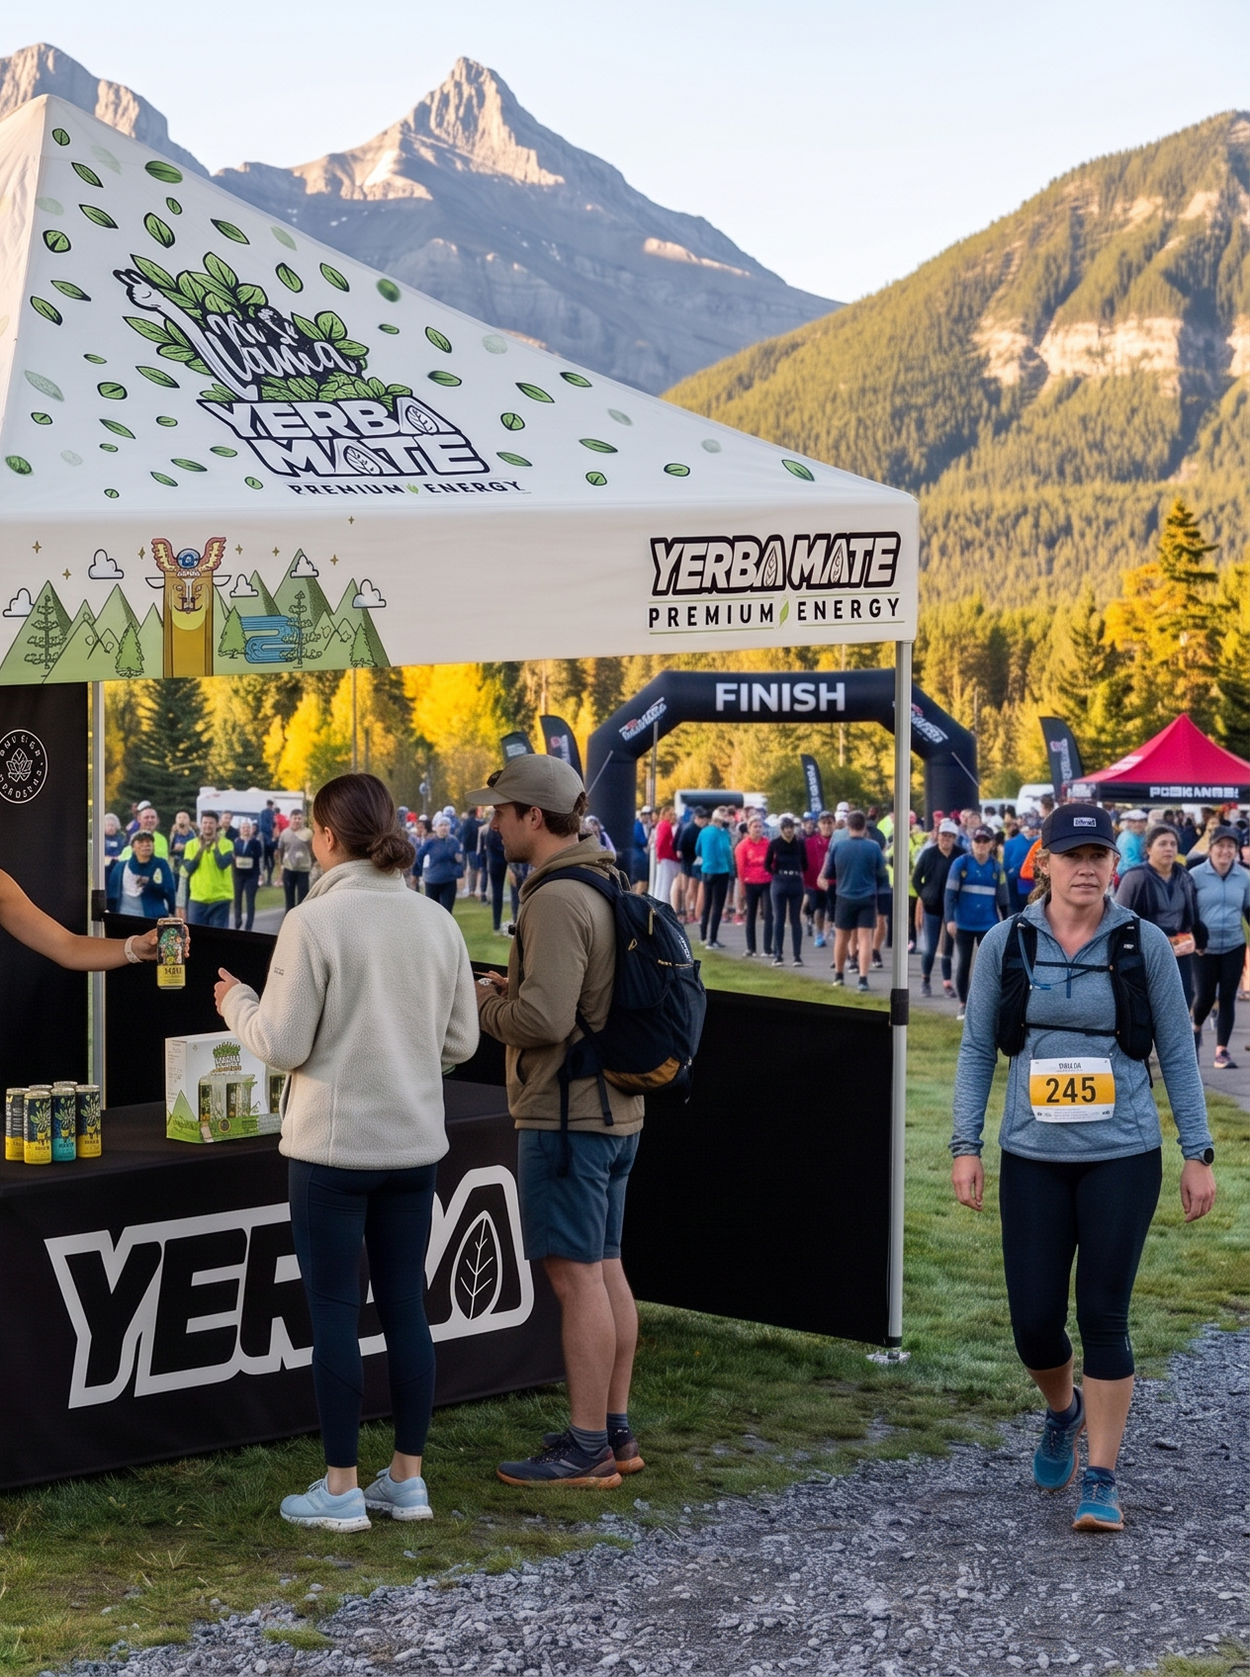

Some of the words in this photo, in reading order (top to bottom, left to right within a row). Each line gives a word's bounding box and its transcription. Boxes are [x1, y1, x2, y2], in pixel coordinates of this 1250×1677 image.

[192, 396, 460, 438] YERBA
[247, 434, 490, 476] MATE
[287, 483, 406, 495] PREMIUM
[423, 480, 526, 495] ENERGY
[650, 534, 787, 596] YERBA
[787, 531, 902, 590] MATE
[648, 602, 775, 629] PREMIUM
[797, 597, 901, 622] ENERGY
[715, 682, 846, 712] FINISH
[1046, 1076, 1096, 1104] 245
